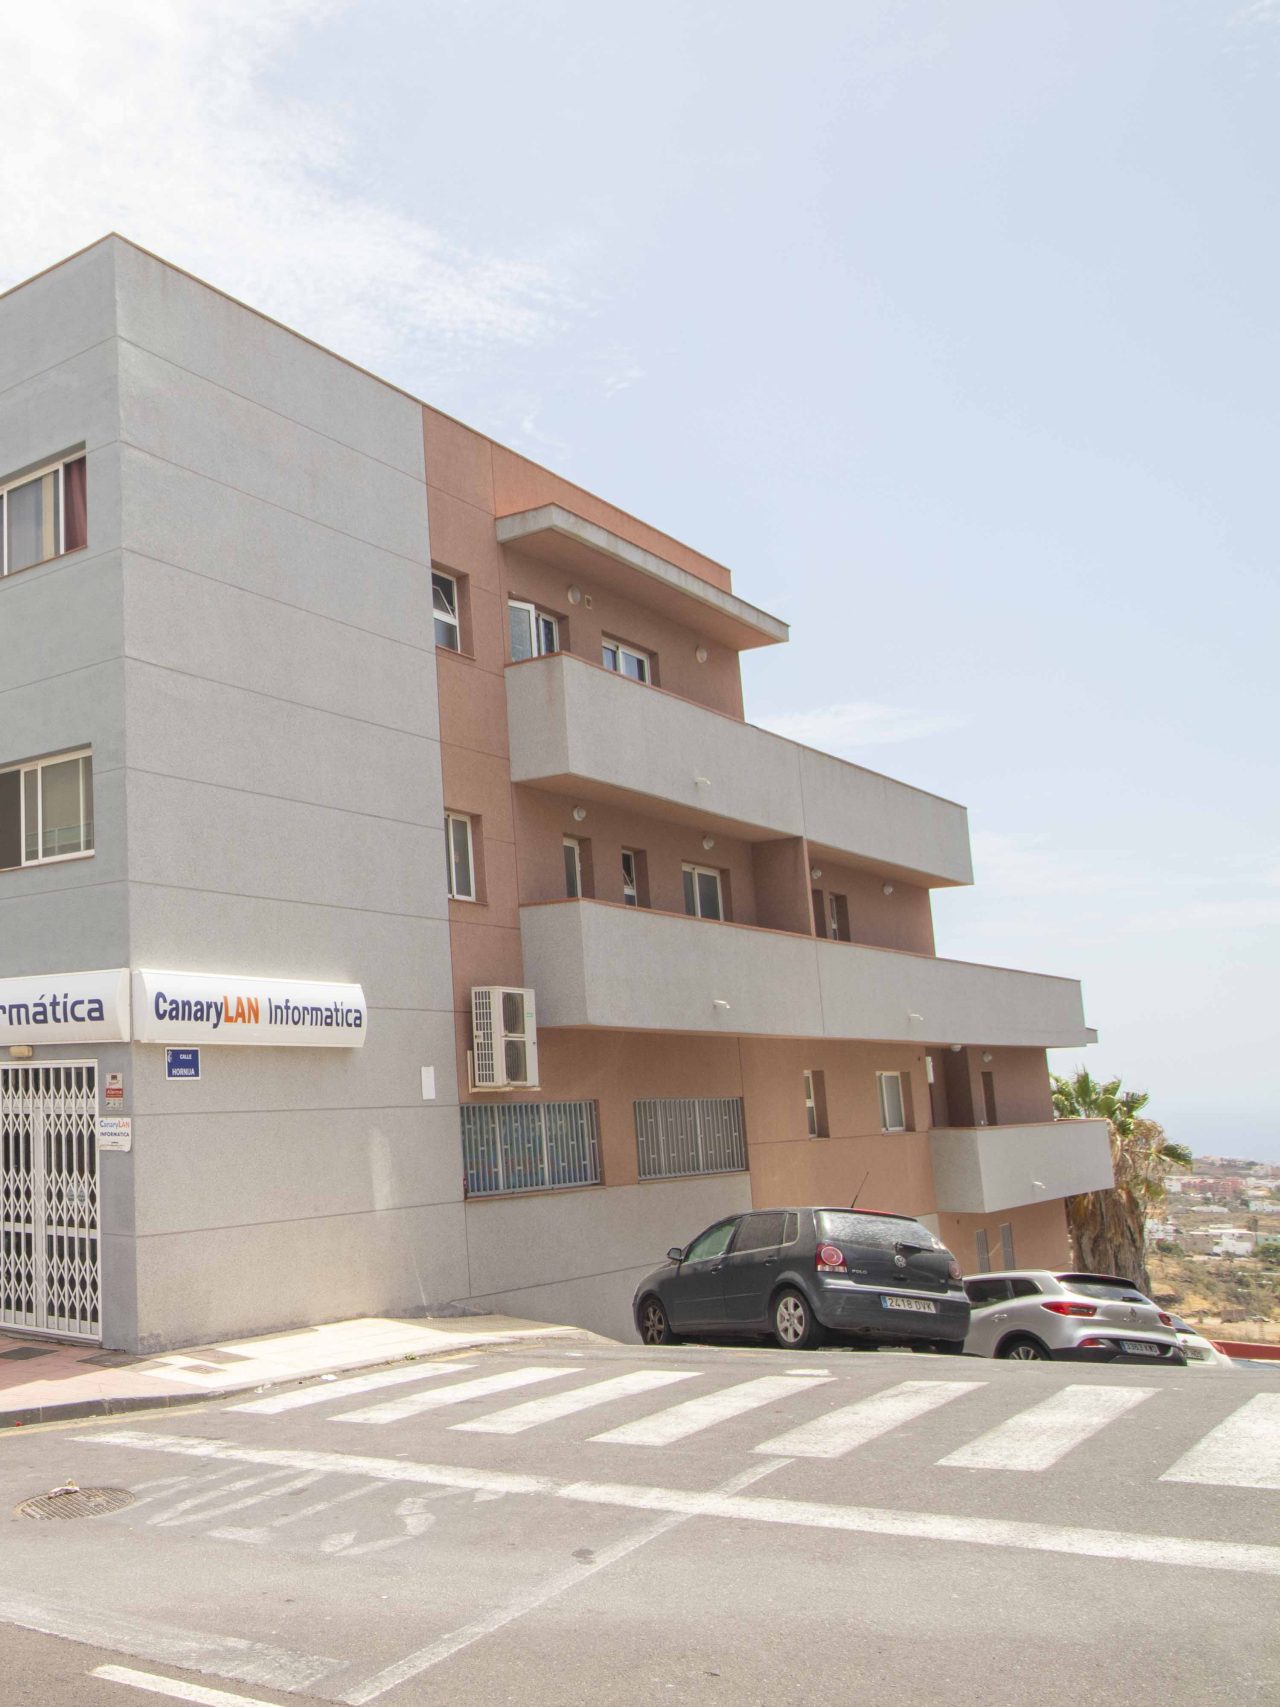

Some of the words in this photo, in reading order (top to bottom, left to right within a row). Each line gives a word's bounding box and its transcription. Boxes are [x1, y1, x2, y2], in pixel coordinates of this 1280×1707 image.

[154, 991, 260, 1029] CanaryLAN
[268, 998, 363, 1028] Informatica
[888, 1296, 913, 1309] 2418
